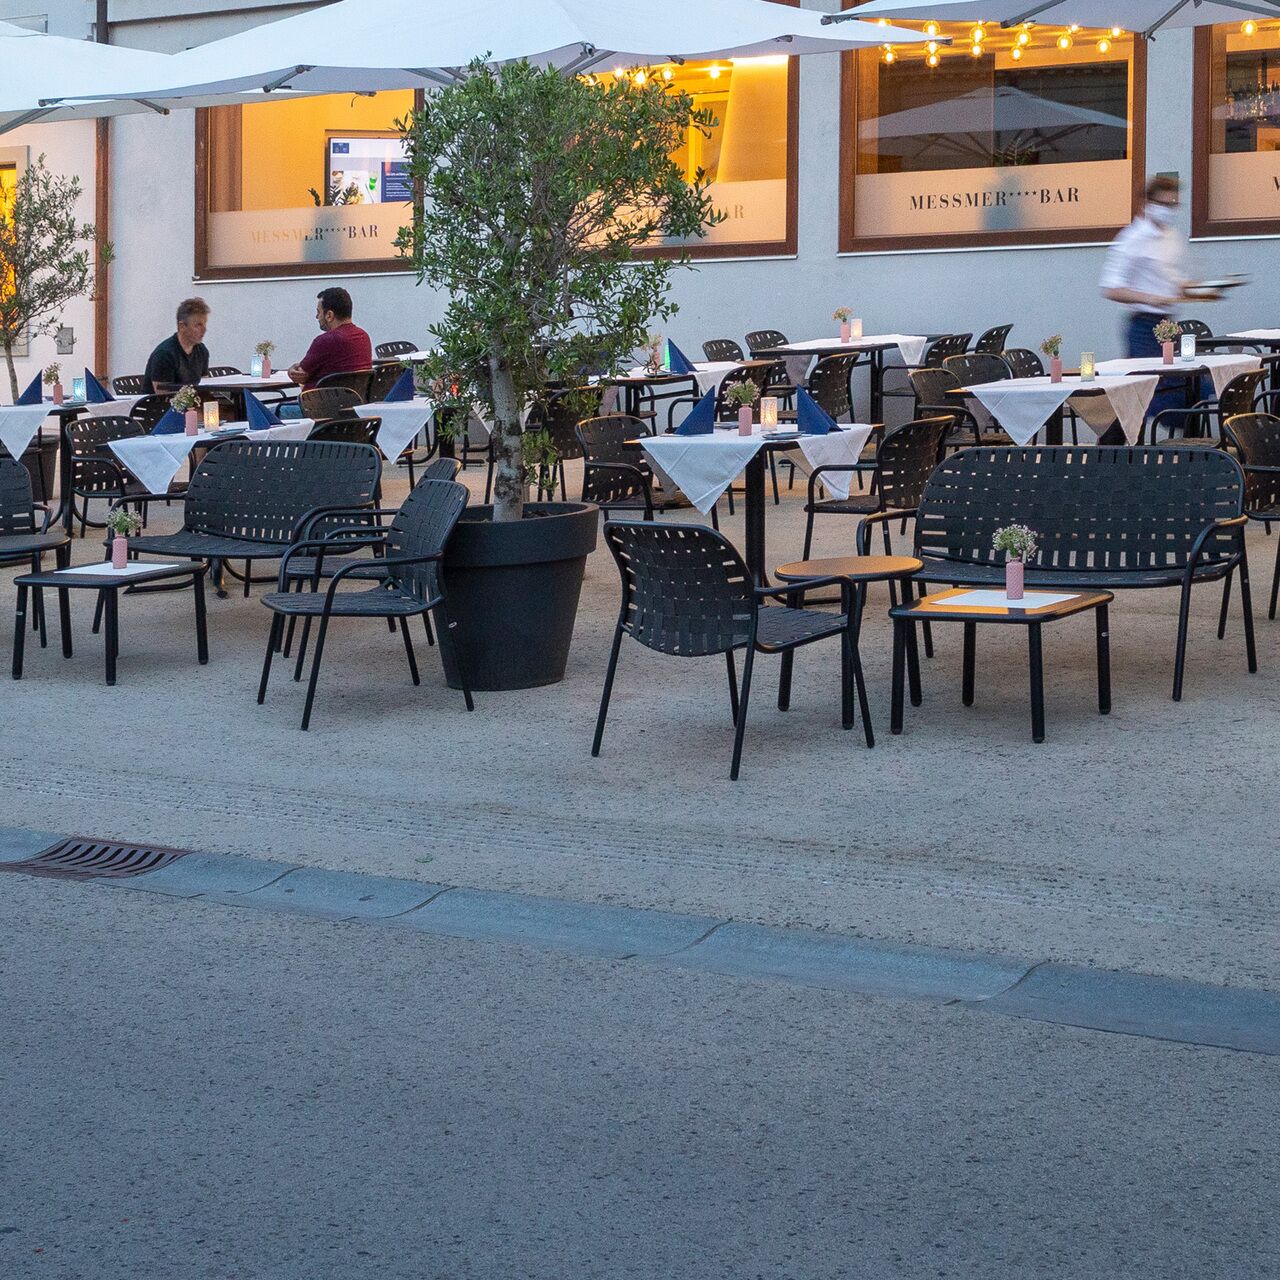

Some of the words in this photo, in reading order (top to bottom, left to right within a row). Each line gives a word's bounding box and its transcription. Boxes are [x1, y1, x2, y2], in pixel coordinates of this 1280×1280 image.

[909, 191, 1008, 211] MESSMER
[1039, 186, 1080, 204] BAR
[348, 224, 379, 239] BAR
